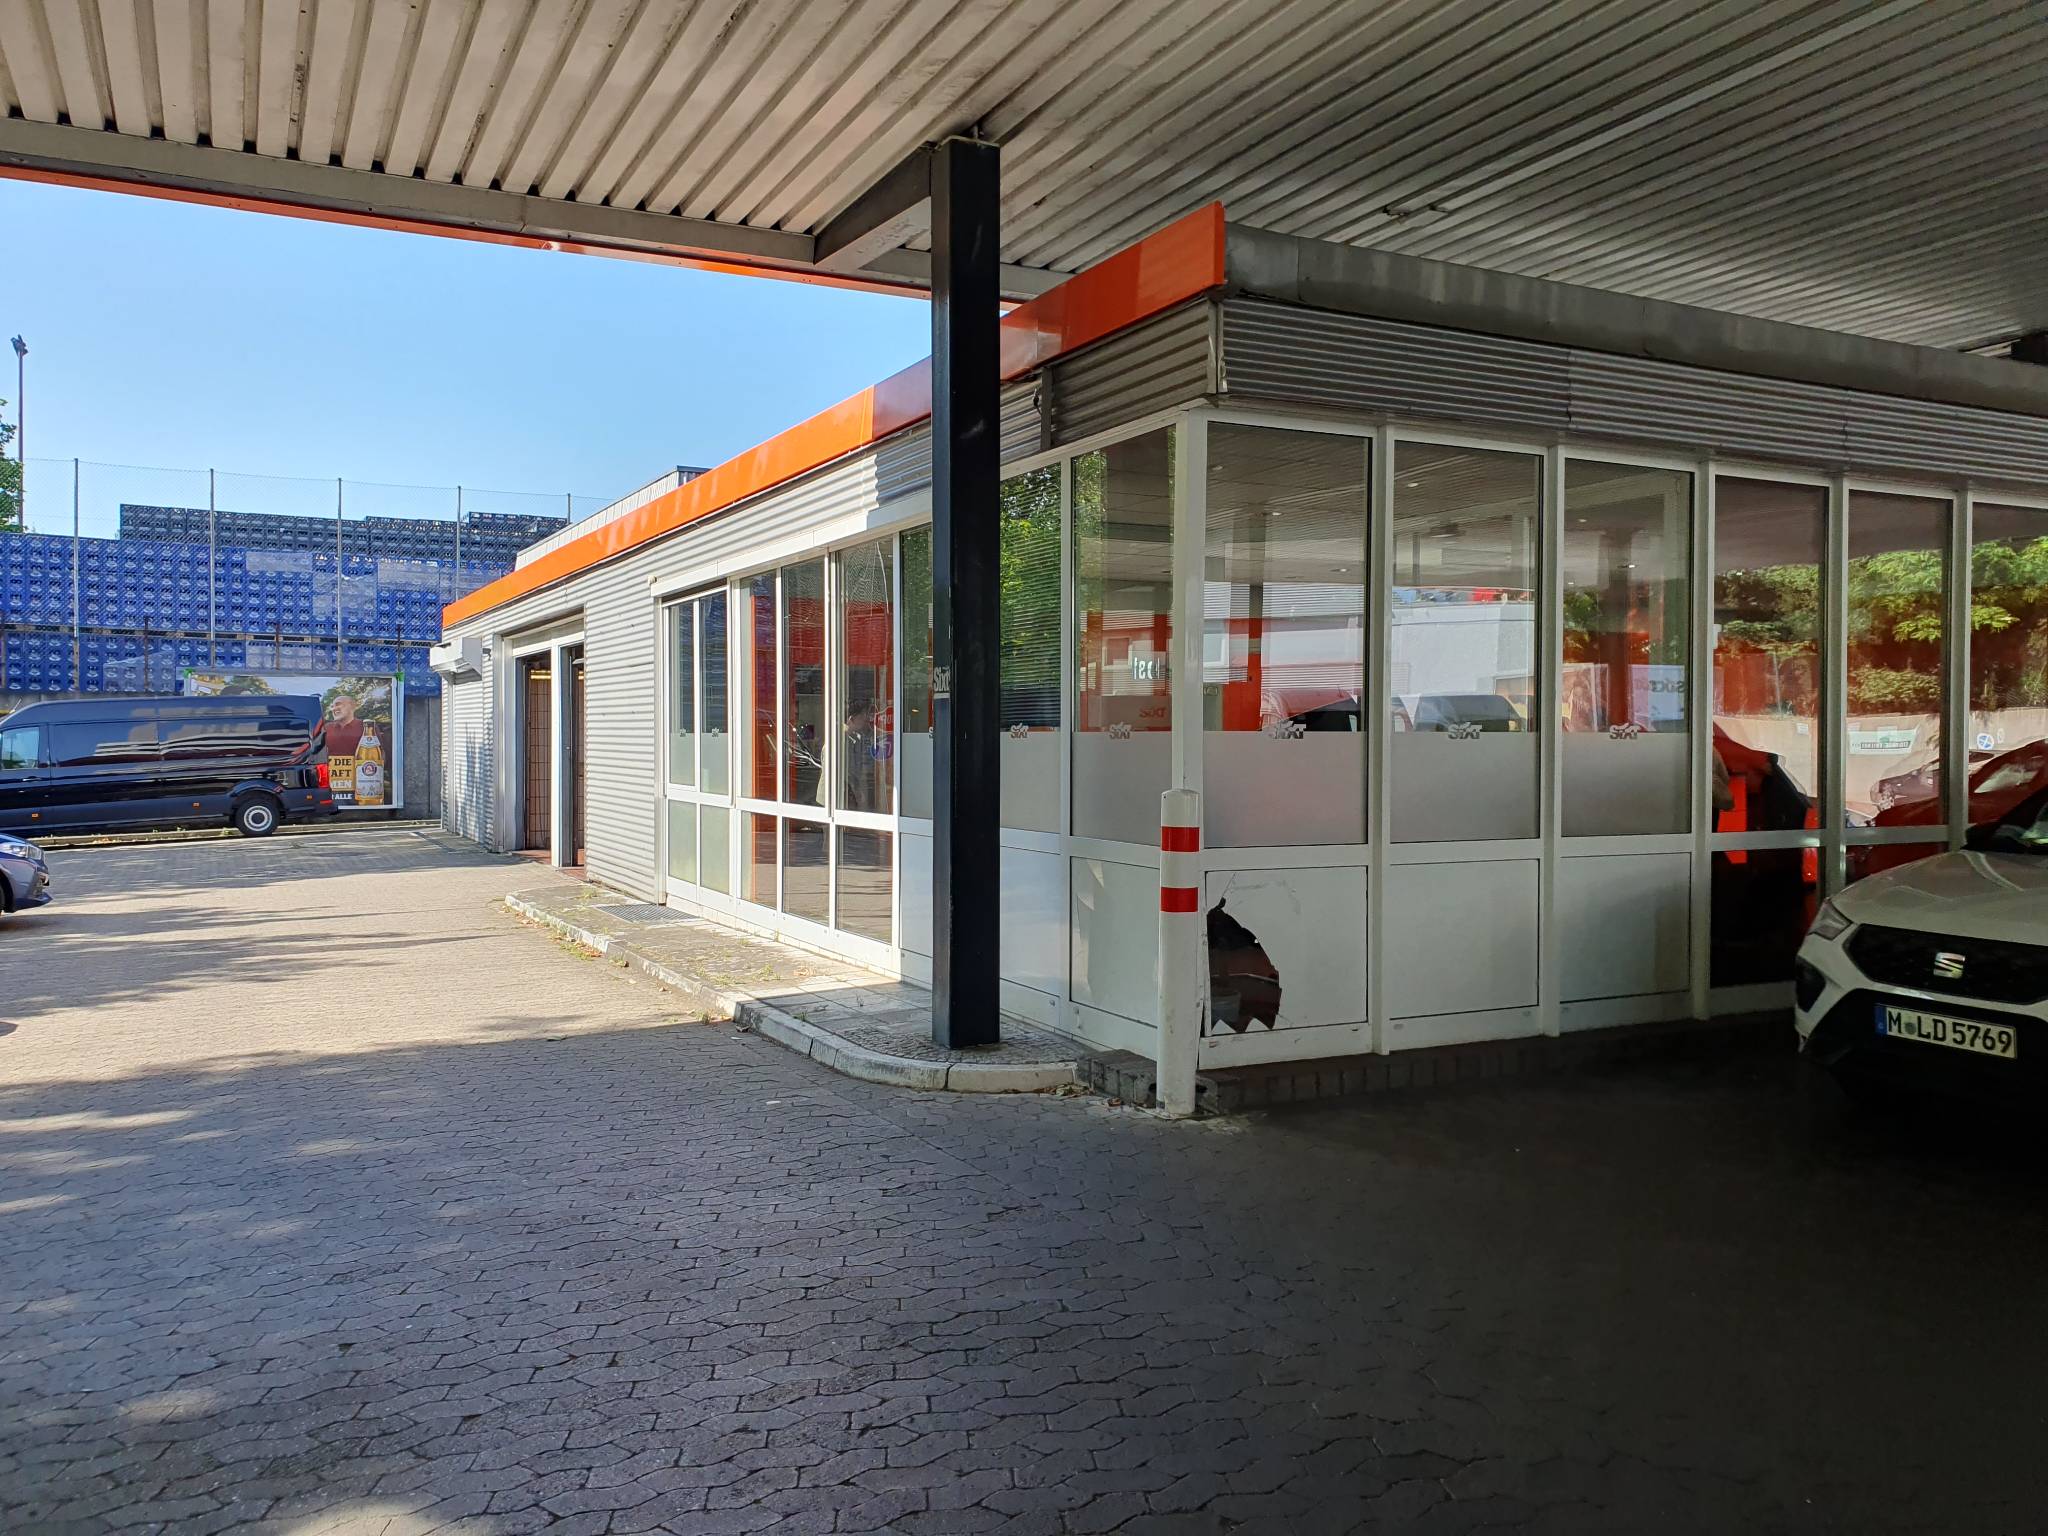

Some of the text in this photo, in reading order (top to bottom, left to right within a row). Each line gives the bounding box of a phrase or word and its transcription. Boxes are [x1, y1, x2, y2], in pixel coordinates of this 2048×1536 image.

[334, 758, 352, 766] DIE
[329, 769, 352, 777] AFT
[1888, 1011, 1902, 1034] M
[1952, 1022, 2013, 1054] 5769
